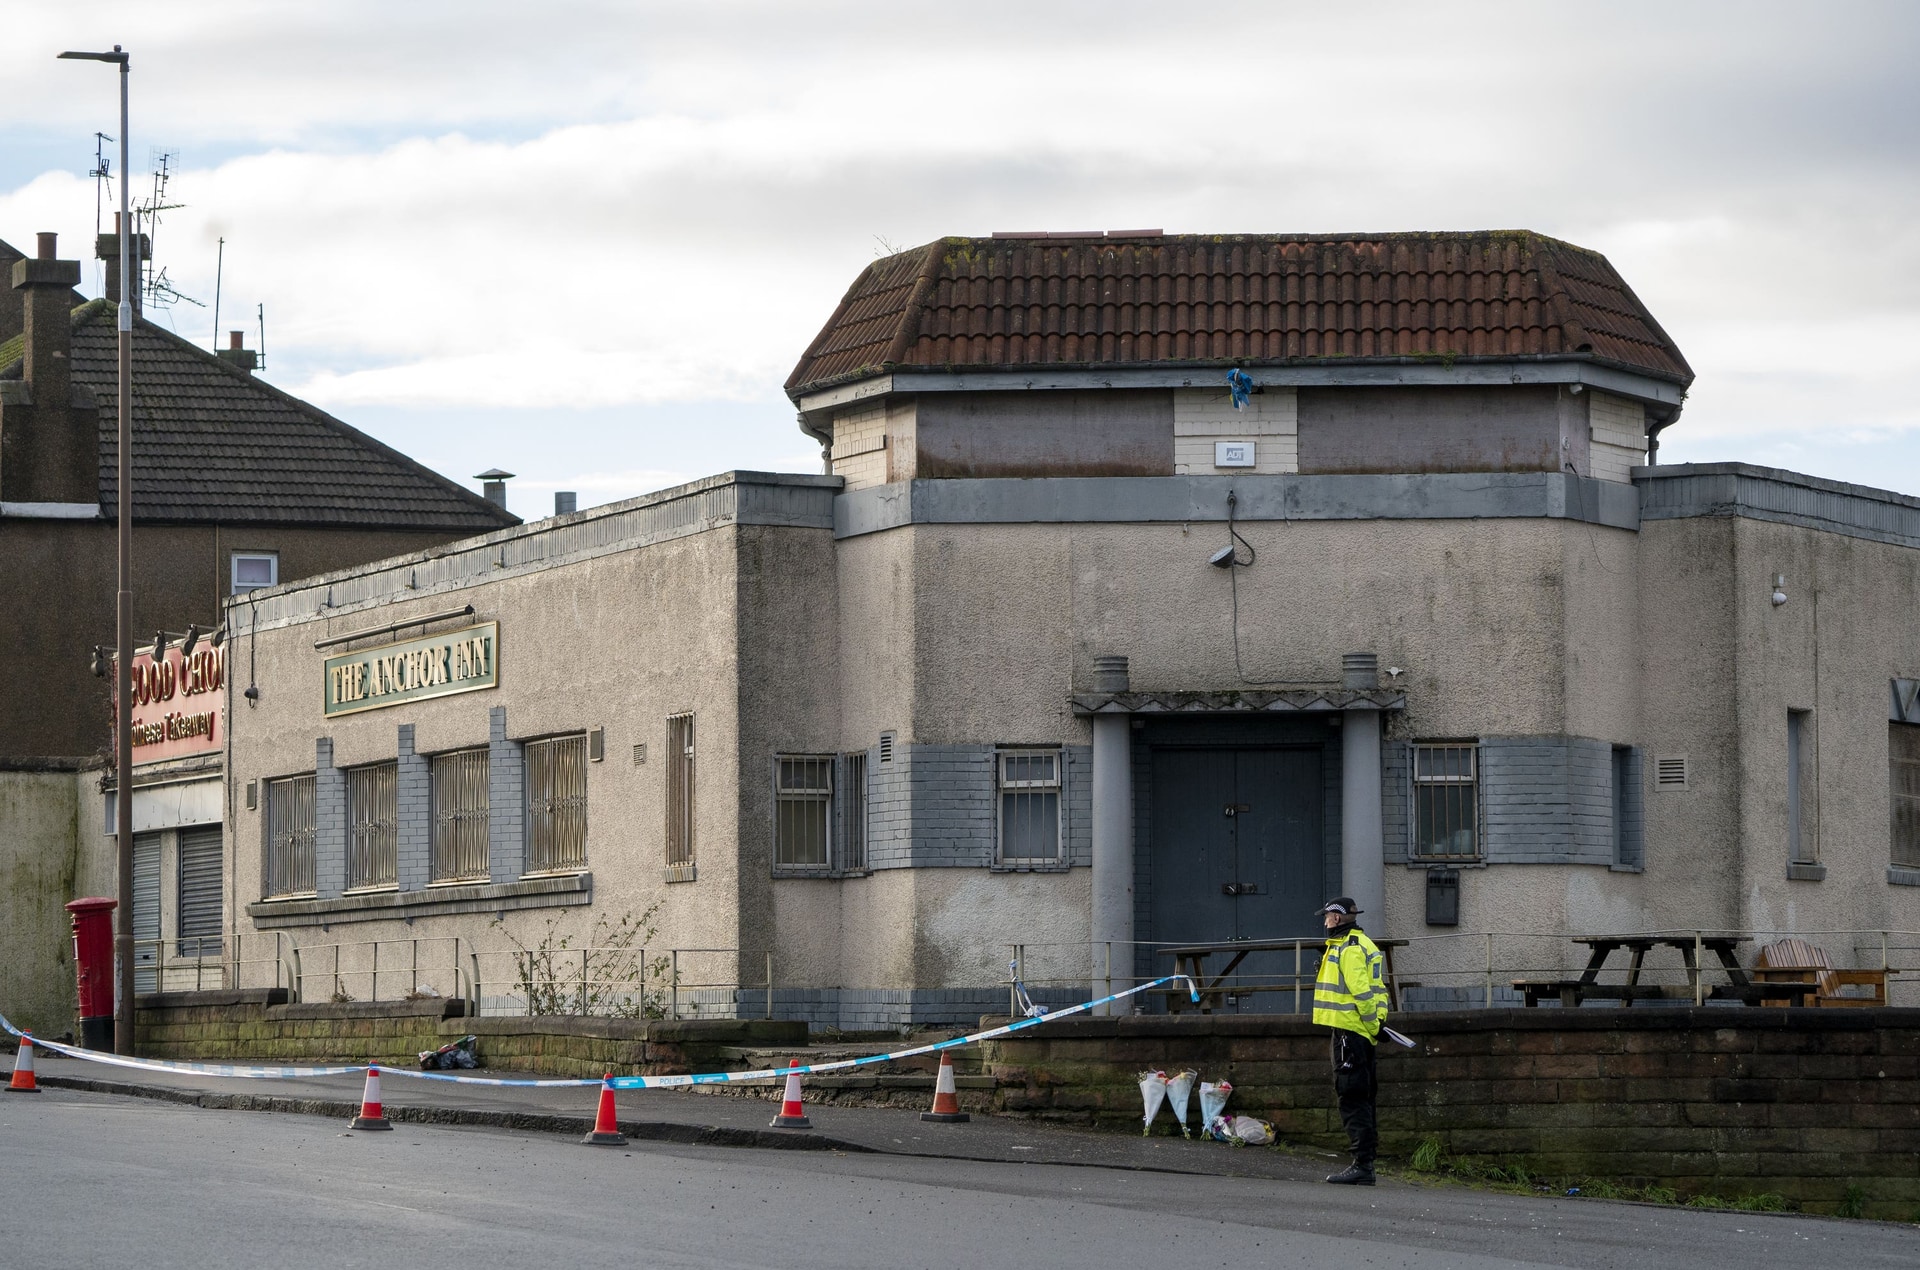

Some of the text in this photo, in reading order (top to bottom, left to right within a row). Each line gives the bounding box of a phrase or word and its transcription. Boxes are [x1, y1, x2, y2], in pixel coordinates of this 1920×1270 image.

[1226, 450, 1245, 459] ADT
[132, 659, 174, 708] OOD
[330, 636, 485, 704] THE ANCHOR INN
[132, 717, 164, 747] hinese
[165, 711, 214, 741] Takeaway
[659, 1077, 685, 1086] POLICE
